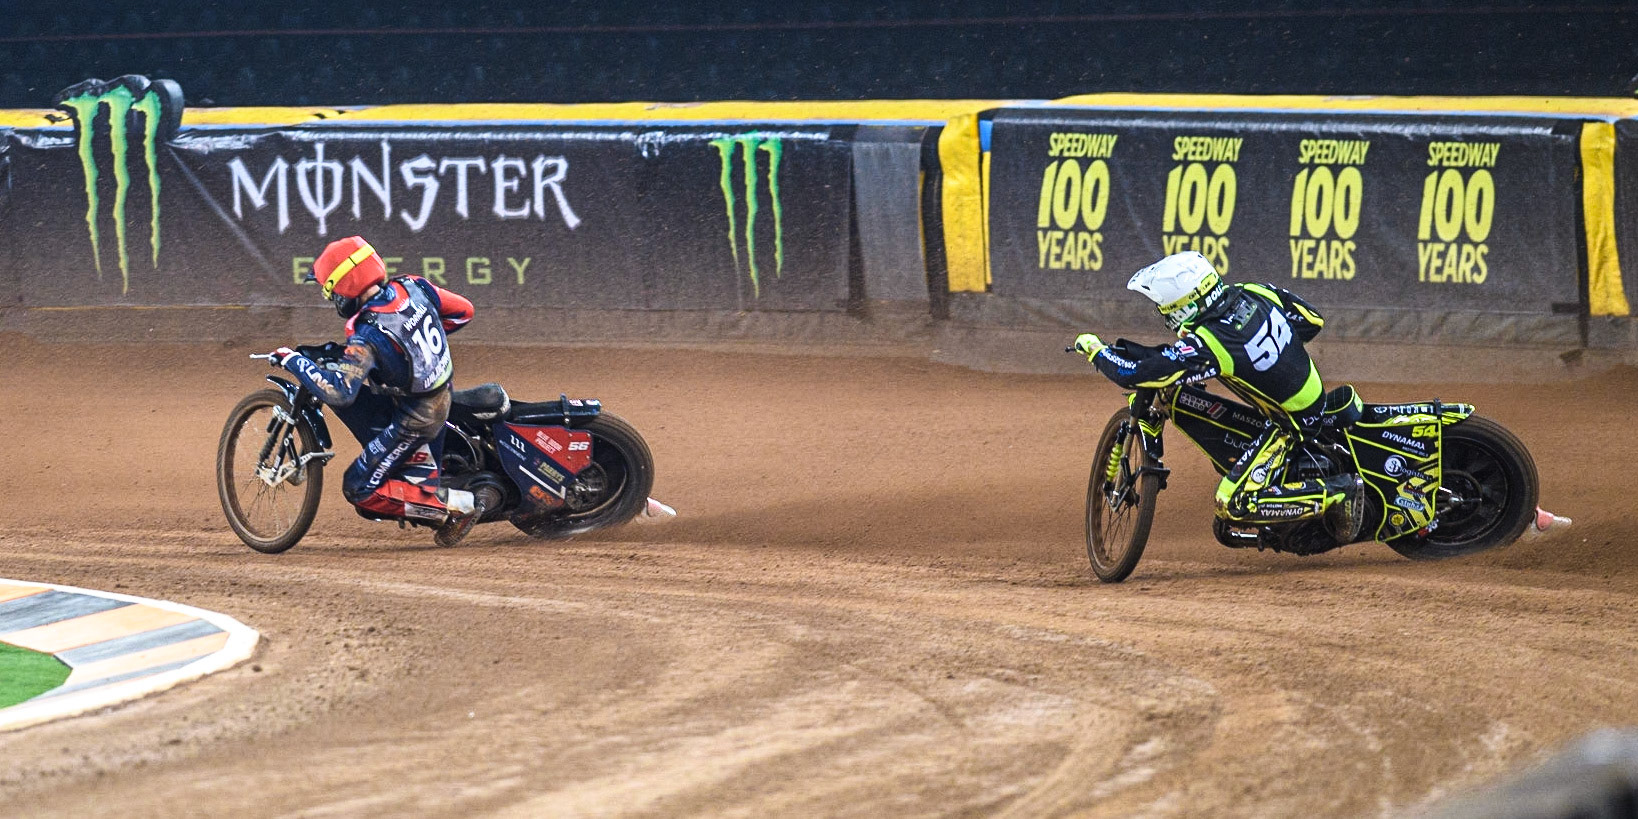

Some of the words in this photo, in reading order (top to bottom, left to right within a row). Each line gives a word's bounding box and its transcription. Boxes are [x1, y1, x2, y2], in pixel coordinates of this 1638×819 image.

[1048, 132, 1118, 158] SPEEDWAY
[1172, 136, 1243, 162] SPEEDWAY
[1298, 139, 1370, 165] SPEEDWAY
[1427, 142, 1500, 167] SPEEDWAY
[228, 141, 581, 235] MONSTER
[1037, 159, 1110, 231] 100
[1162, 162, 1237, 235] 100
[1290, 165, 1363, 239] 100
[1418, 168, 1495, 243] 100
[292, 256, 532, 286] EERGY
[1037, 230, 1103, 271] YEARS
[1289, 238, 1356, 281] YEARS
[1417, 241, 1488, 284] YEARS
[411, 314, 443, 365] 16
[1243, 306, 1293, 372] 54
[1186, 367, 1217, 384] ANLAS
[1232, 411, 1265, 429] MASZO
[1381, 430, 1426, 450] DYNAMAX
[1412, 424, 1437, 438] 54
